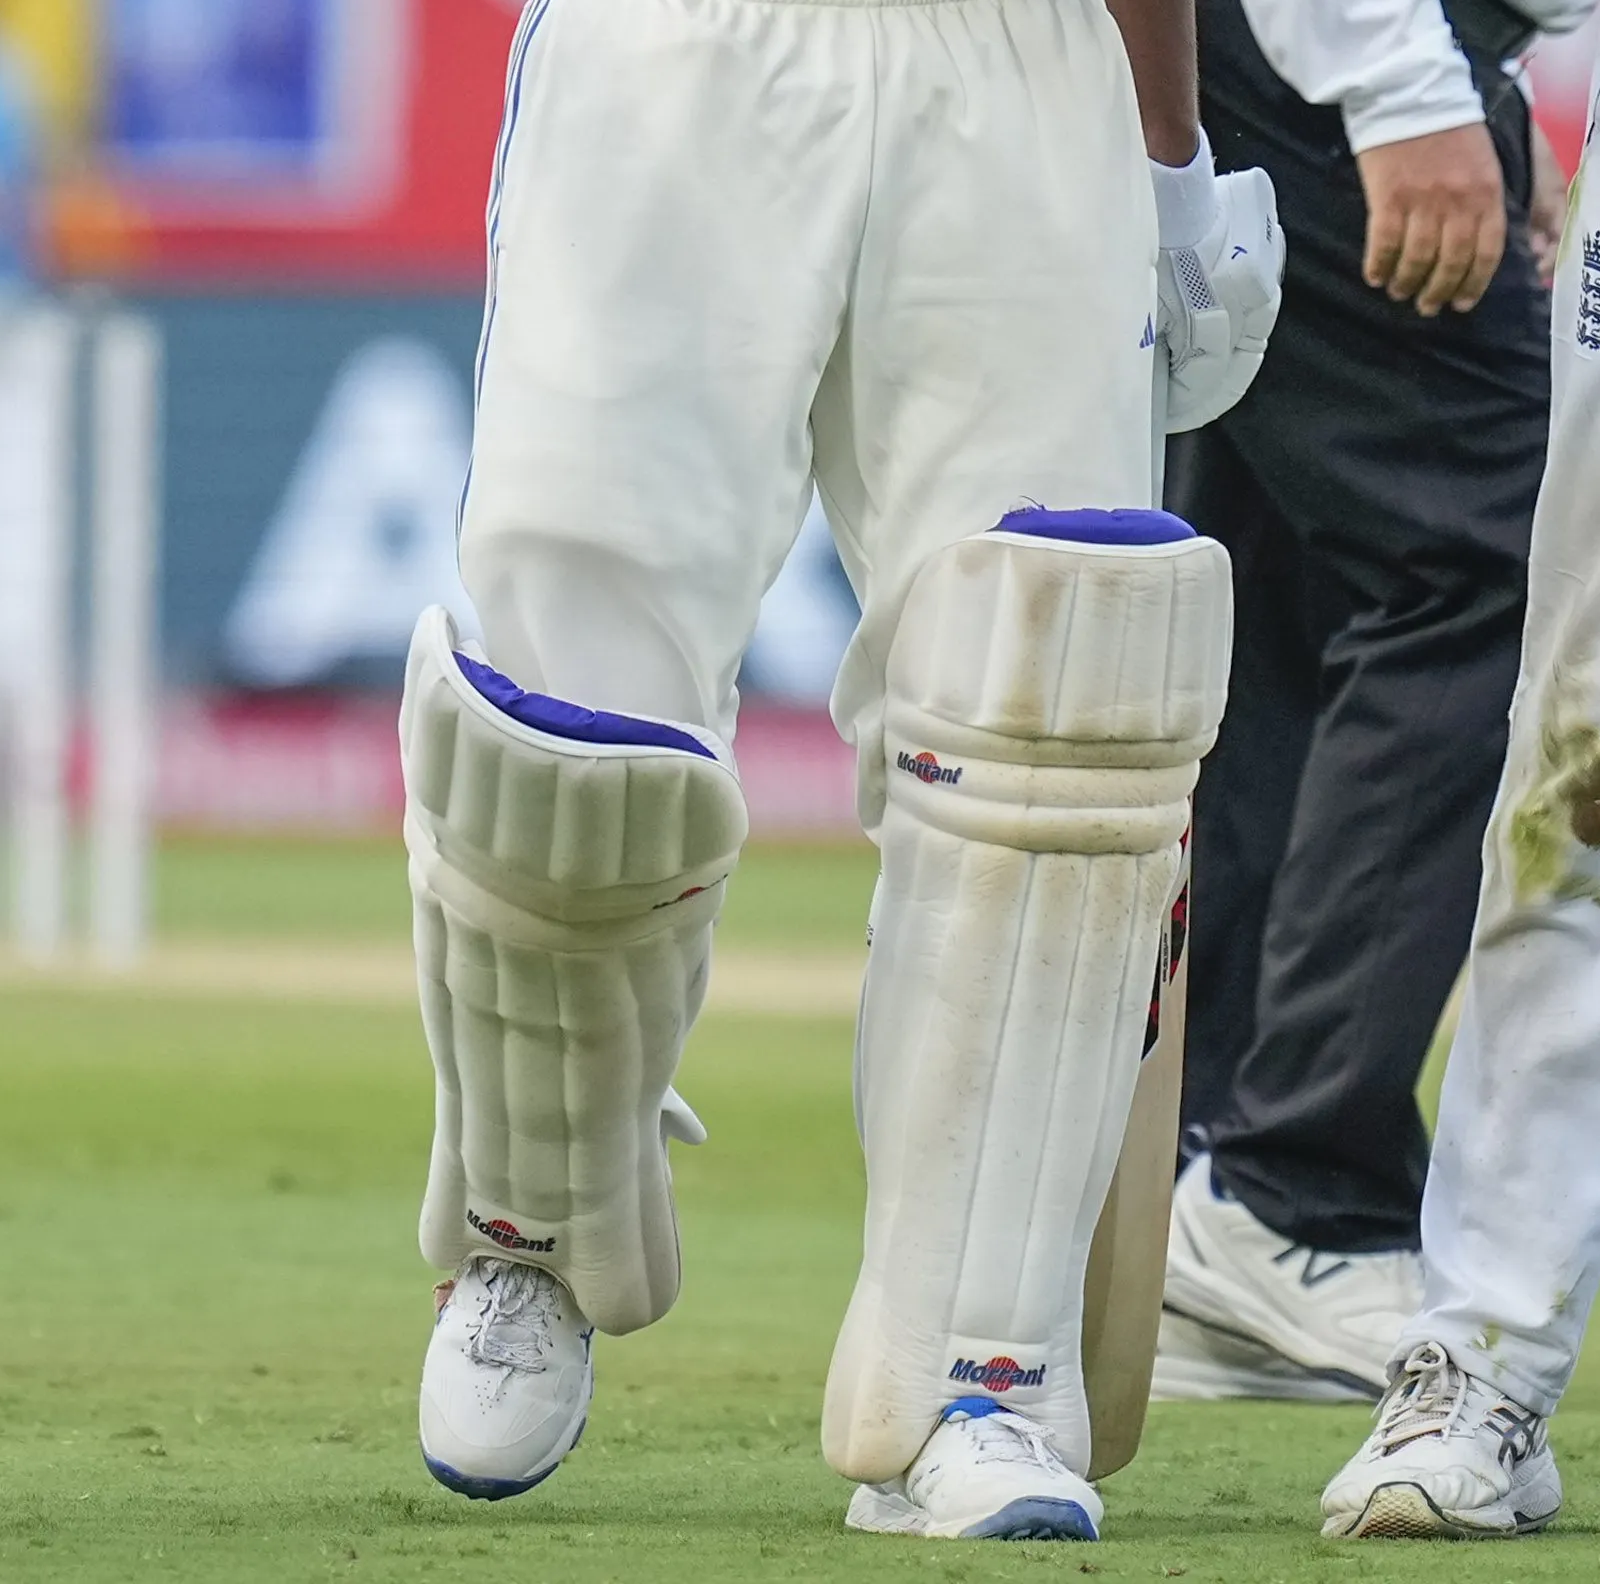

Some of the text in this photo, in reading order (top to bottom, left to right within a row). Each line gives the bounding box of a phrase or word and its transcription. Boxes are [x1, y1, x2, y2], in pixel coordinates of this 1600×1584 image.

[896, 751, 963, 785] Morrant
[467, 1209, 557, 1252] Morrant
[949, 1358, 1047, 1386] Morrant
